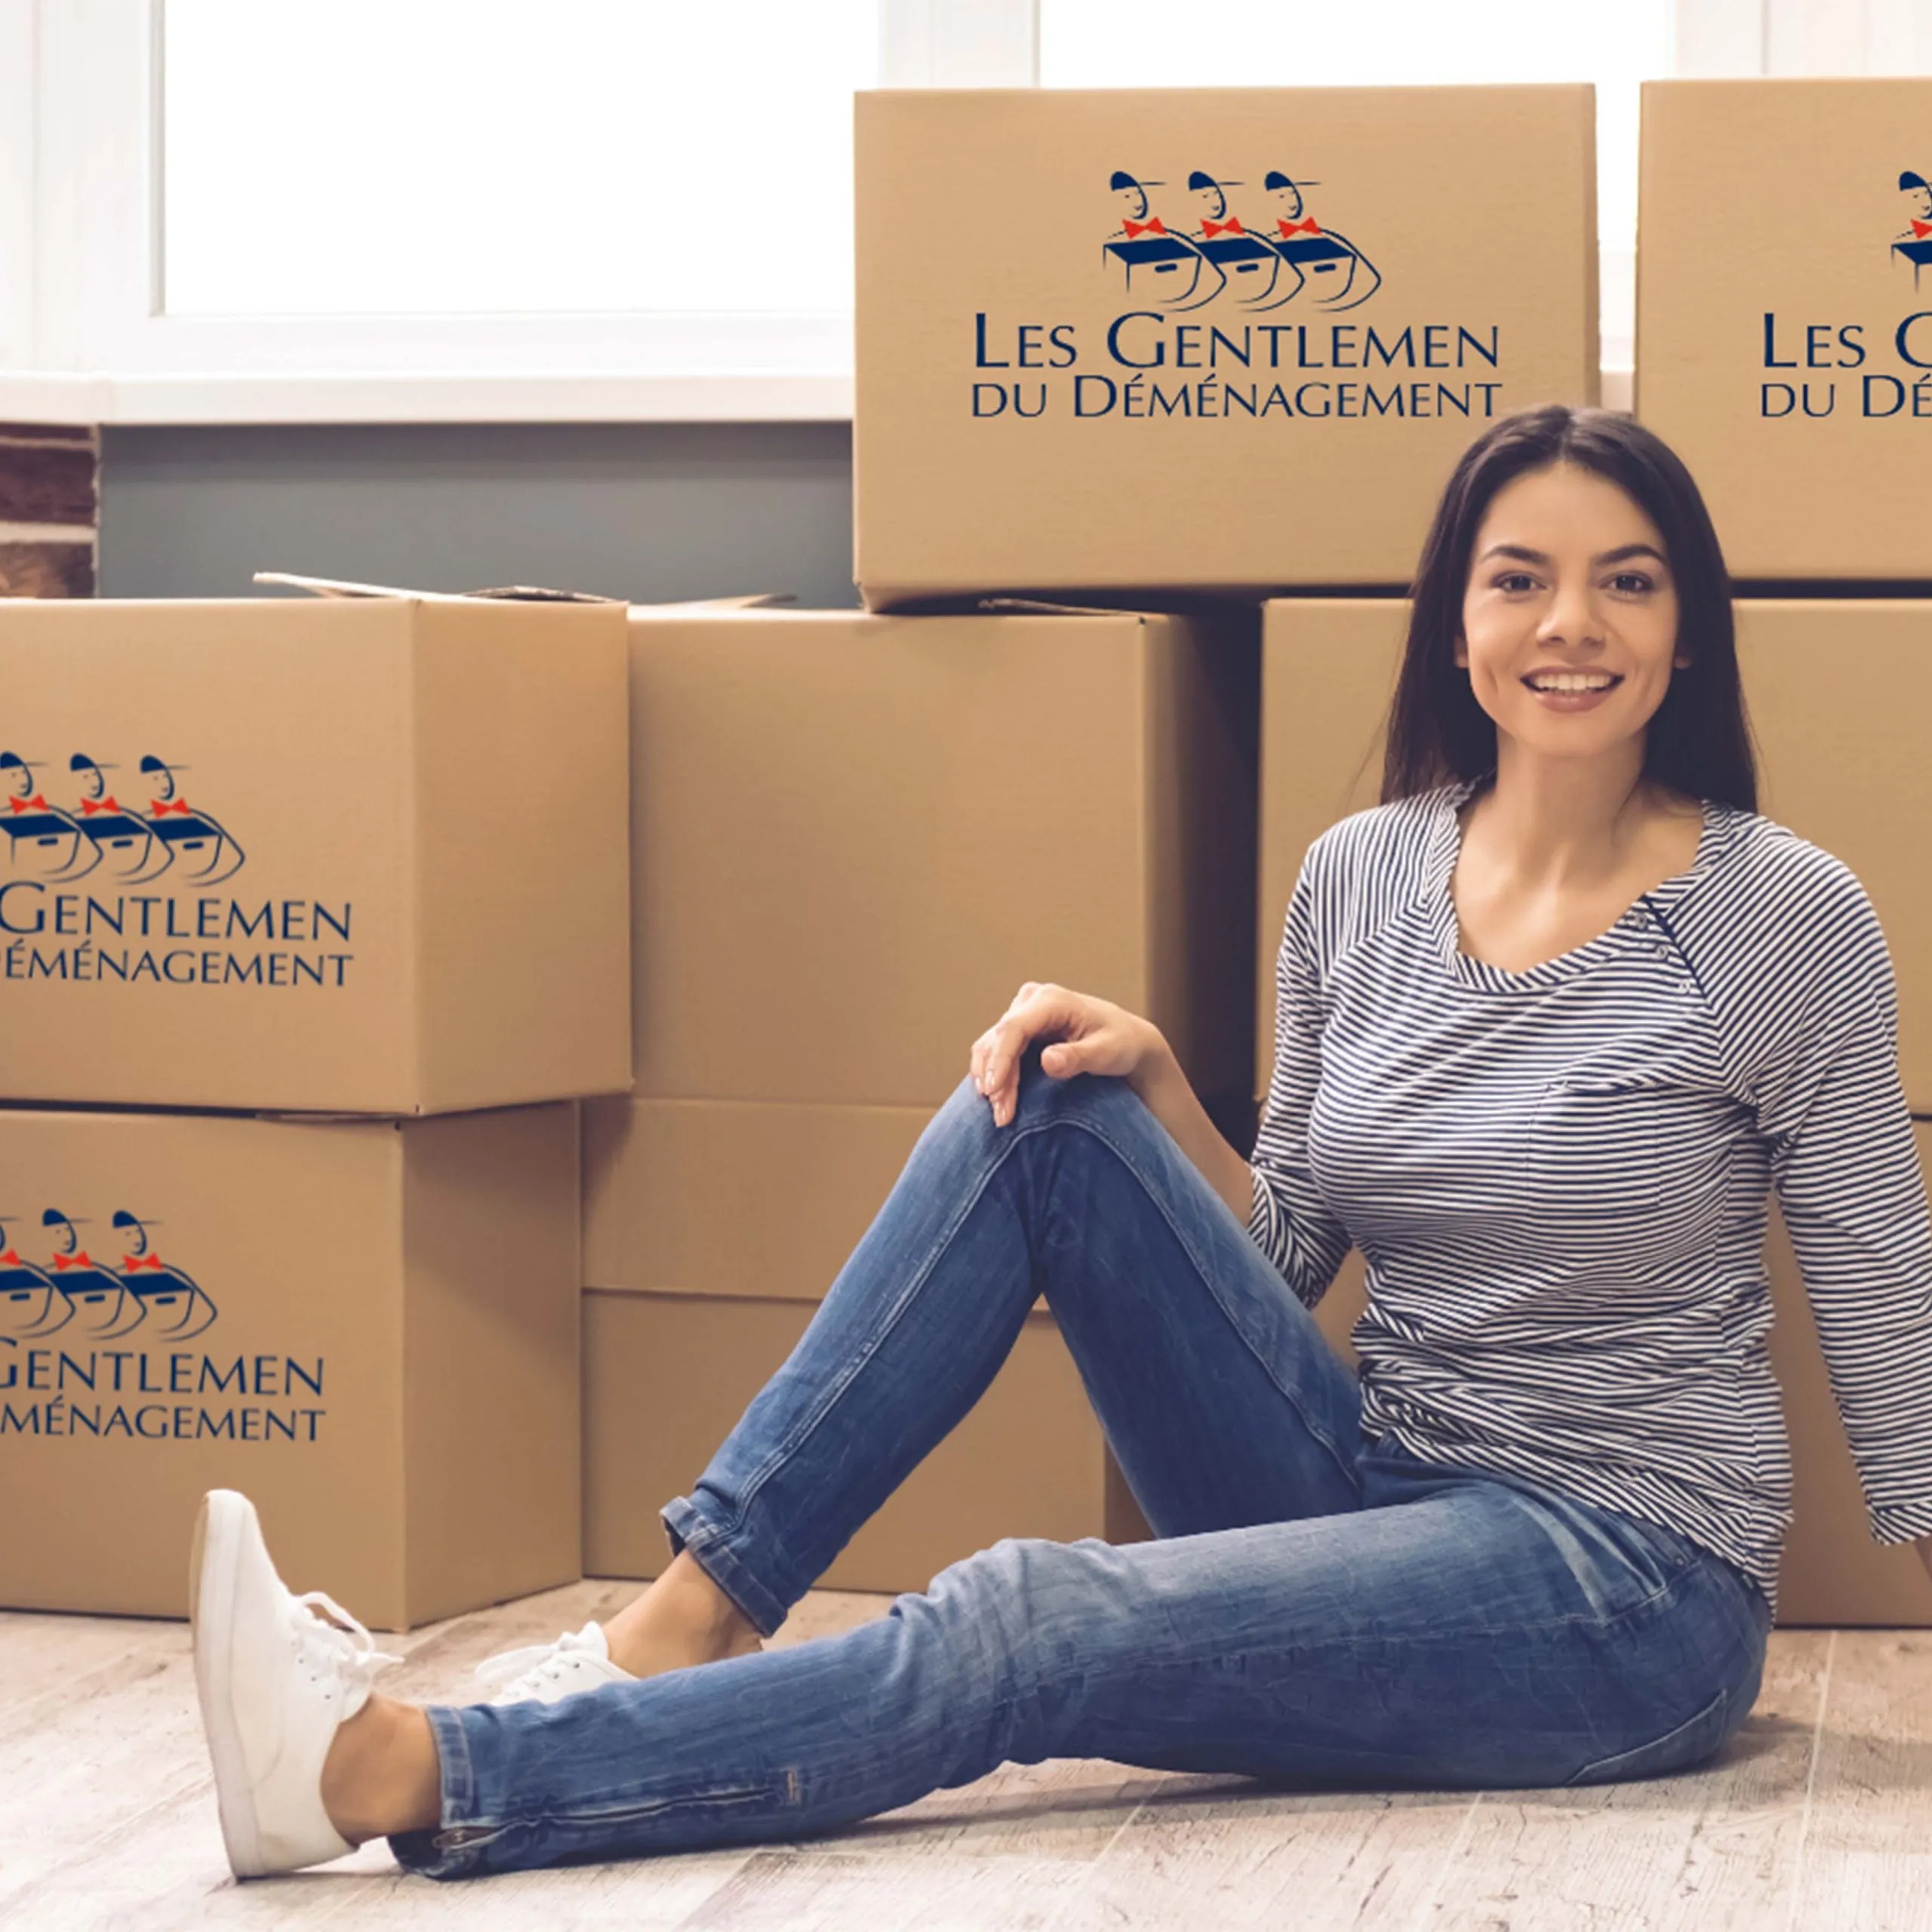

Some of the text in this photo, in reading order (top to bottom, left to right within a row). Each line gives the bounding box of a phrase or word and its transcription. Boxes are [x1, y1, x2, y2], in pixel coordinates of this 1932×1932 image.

[976, 312, 1498, 368] LES GENTLEMEN
[1764, 312, 1866, 368] LES
[973, 373, 1503, 417] DU DÉMÉNAGEMENT
[1761, 383, 1835, 417] DU
[0, 937, 353, 986] ÉMÉNAGEMENT
